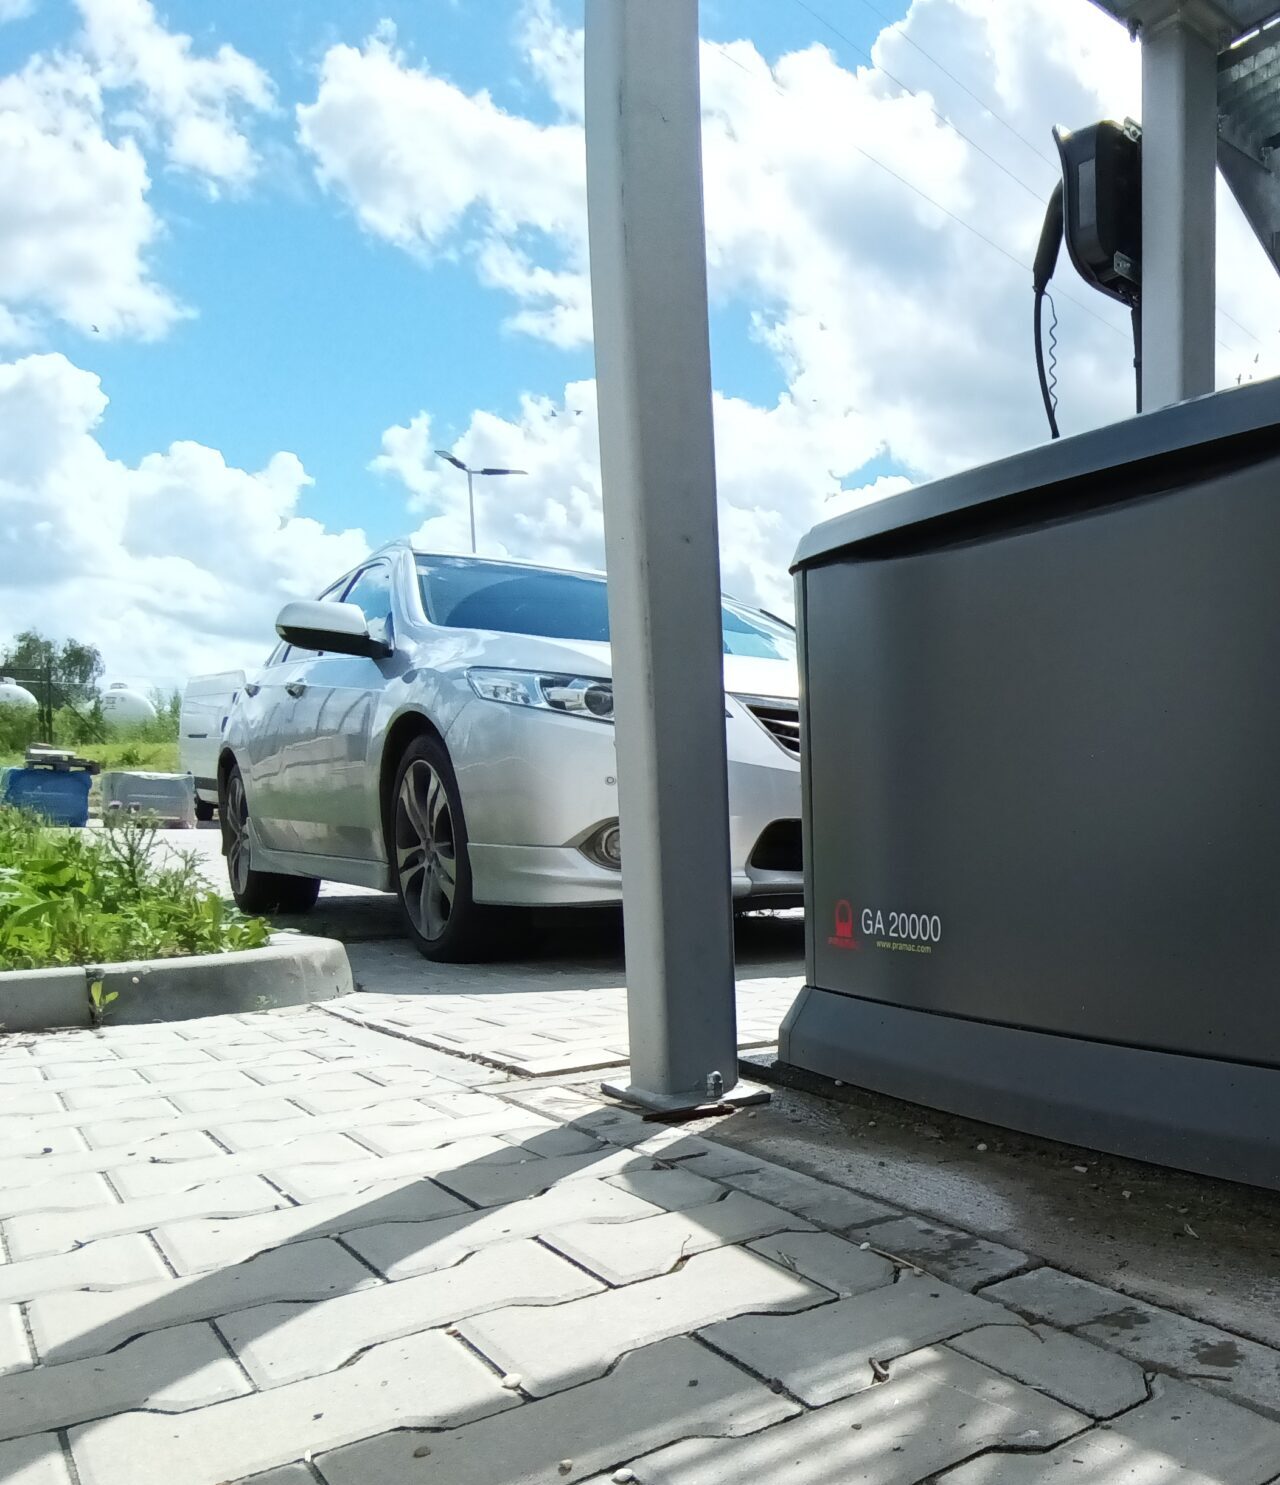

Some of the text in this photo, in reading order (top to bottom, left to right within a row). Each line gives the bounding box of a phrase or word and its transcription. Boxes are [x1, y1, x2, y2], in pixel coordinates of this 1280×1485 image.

[861, 908, 941, 942] GA 20000
[876, 939, 932, 953] www.pramac.com
